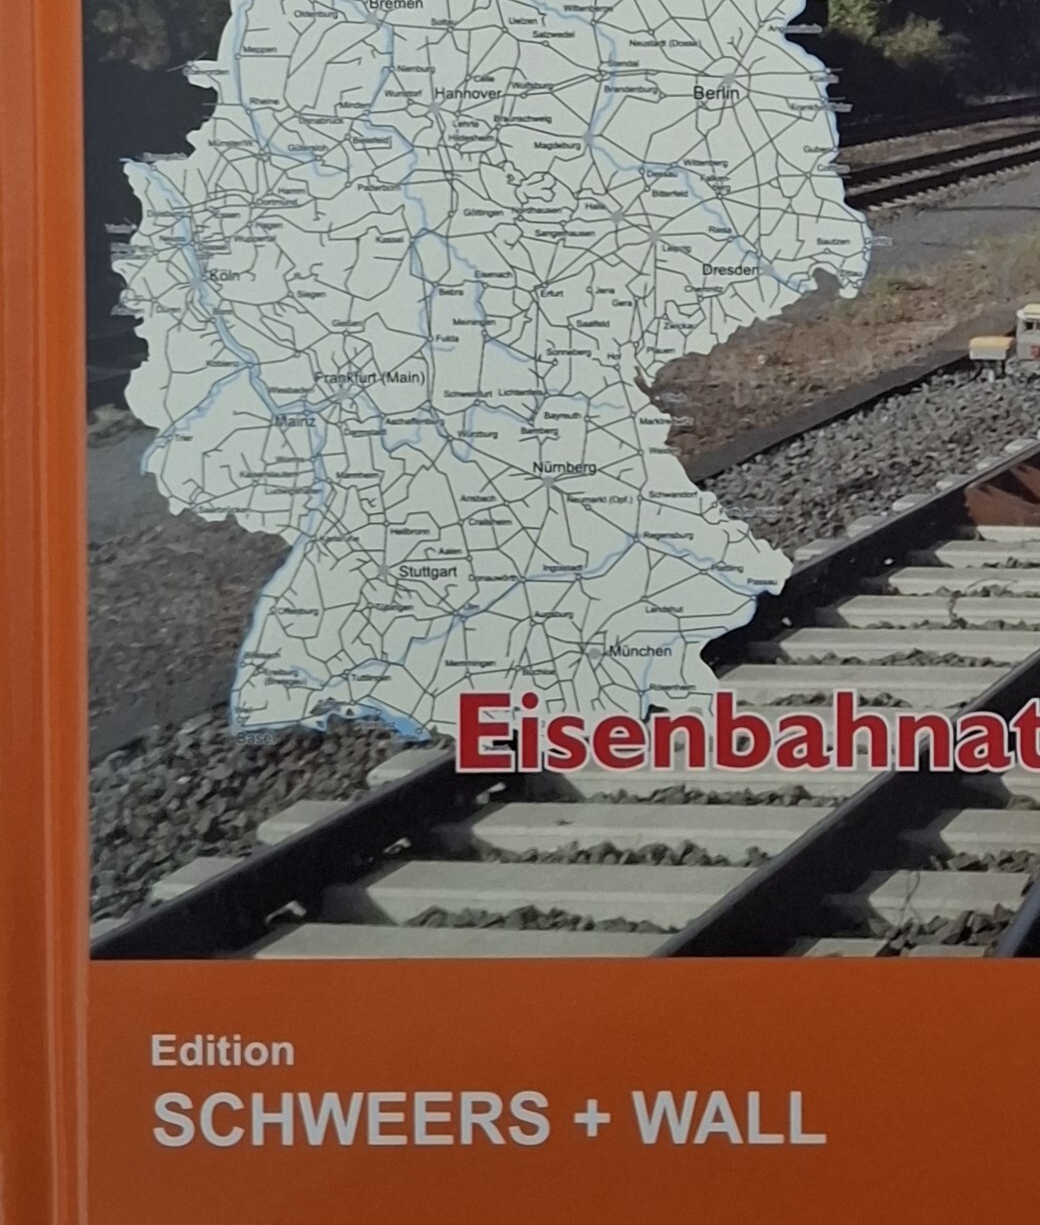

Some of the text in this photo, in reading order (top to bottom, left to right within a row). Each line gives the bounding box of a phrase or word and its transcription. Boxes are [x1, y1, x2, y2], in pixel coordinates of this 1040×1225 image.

[294, 9, 338, 20] Oldenburg
[508, 17, 538, 25] Uelzen
[243, 46, 277, 54] Meppen
[397, 65, 436, 74] Nienburg
[434, 87, 502, 100] Hannover
[604, 85, 659, 94] Brandenburg
[693, 86, 740, 100] Berlin
[534, 142, 581, 151] Magdeburg
[463, 208, 504, 217] Göttingen
[535, 230, 595, 238] Sangerhausen
[702, 263, 760, 276] Dresden
[210, 269, 240, 281] Köln
[297, 291, 326, 299] Siegen
[546, 348, 592, 357] Sonneberg
[314, 372, 425, 386] Frankfurt (Main)
[544, 412, 582, 420] Bayreuth
[275, 416, 316, 427] Mainz
[521, 427, 559, 435] Bamberg
[533, 461, 597, 475] Nürnberg
[460, 494, 496, 502] Ansbach
[399, 565, 457, 580] Stuttgart
[609, 645, 672, 657] München
[150, 1034, 295, 1067] Edition
[153, 1090, 827, 1148] SCHWEERS + WALL
